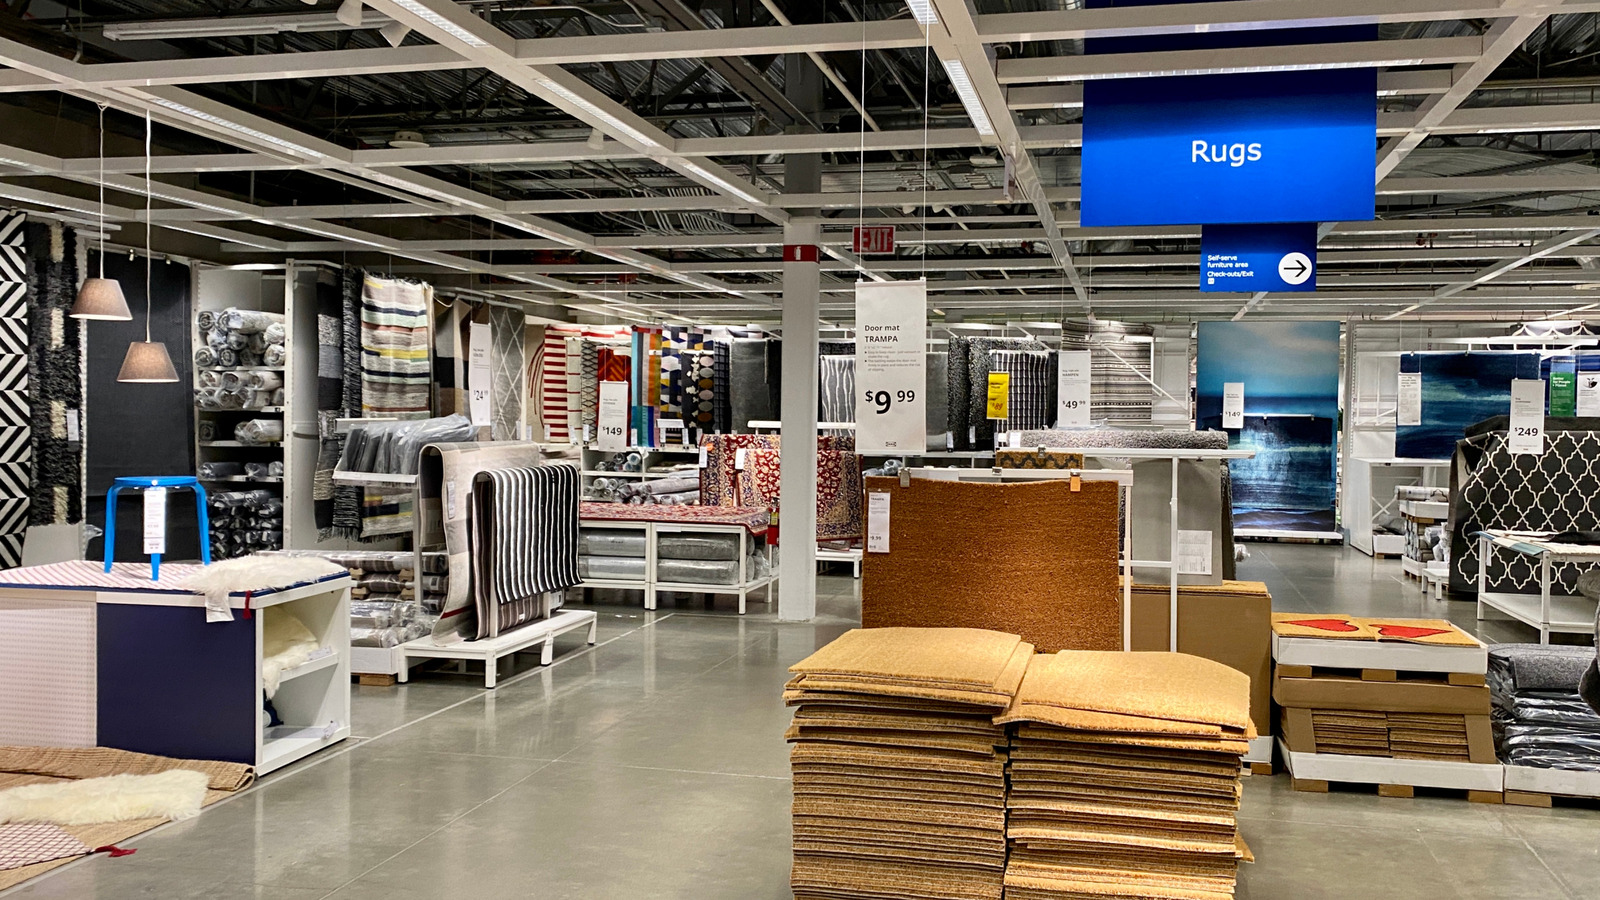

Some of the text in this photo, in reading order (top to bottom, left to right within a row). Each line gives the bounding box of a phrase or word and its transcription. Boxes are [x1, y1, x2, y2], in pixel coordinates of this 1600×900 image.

[1191, 139, 1262, 167] Rugs
[860, 228, 890, 251] EXIT
[865, 390, 915, 414] $9 99
[602, 426, 622, 435] $149
[1514, 427, 1538, 436] $249
